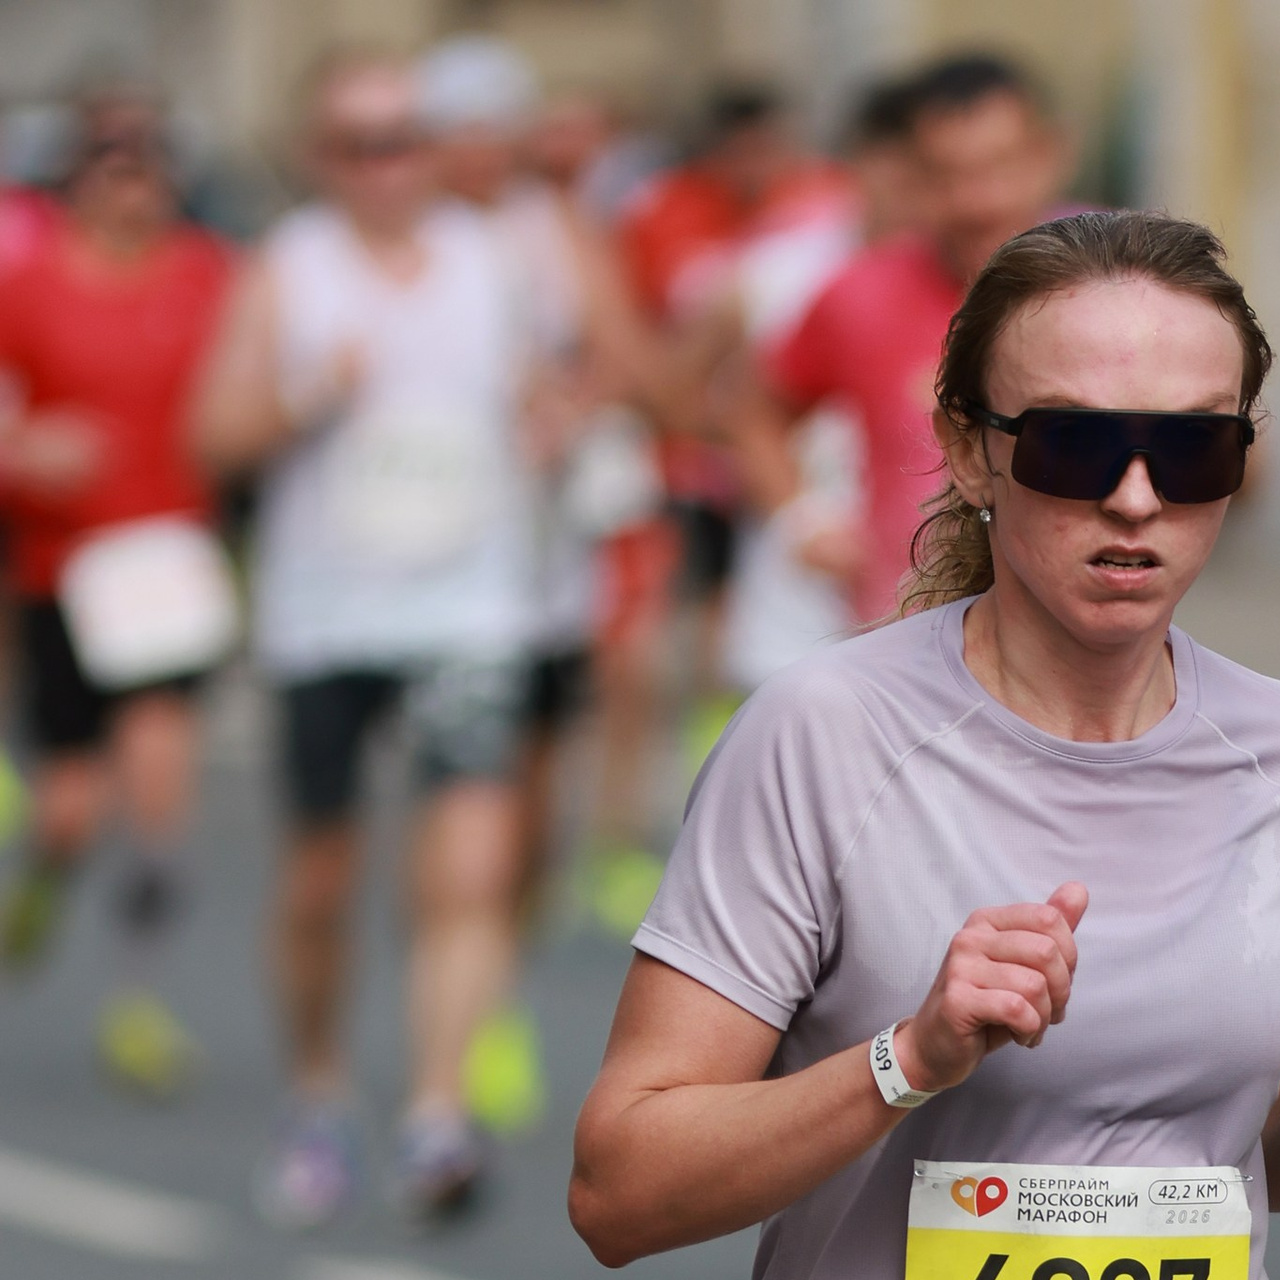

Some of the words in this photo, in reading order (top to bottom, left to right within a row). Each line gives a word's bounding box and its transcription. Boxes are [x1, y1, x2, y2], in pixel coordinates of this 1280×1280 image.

[1019, 1178, 1109, 1190] СБЕРПРАЙМ
[1018, 1192, 1139, 1208] МОСКОВСКИЙ
[1158, 1184, 1191, 1201] 42,2
[1196, 1184, 1218, 1198] КМ
[1017, 1208, 1107, 1224] МАРАФОН
[1165, 1209, 1211, 1224] 2026
